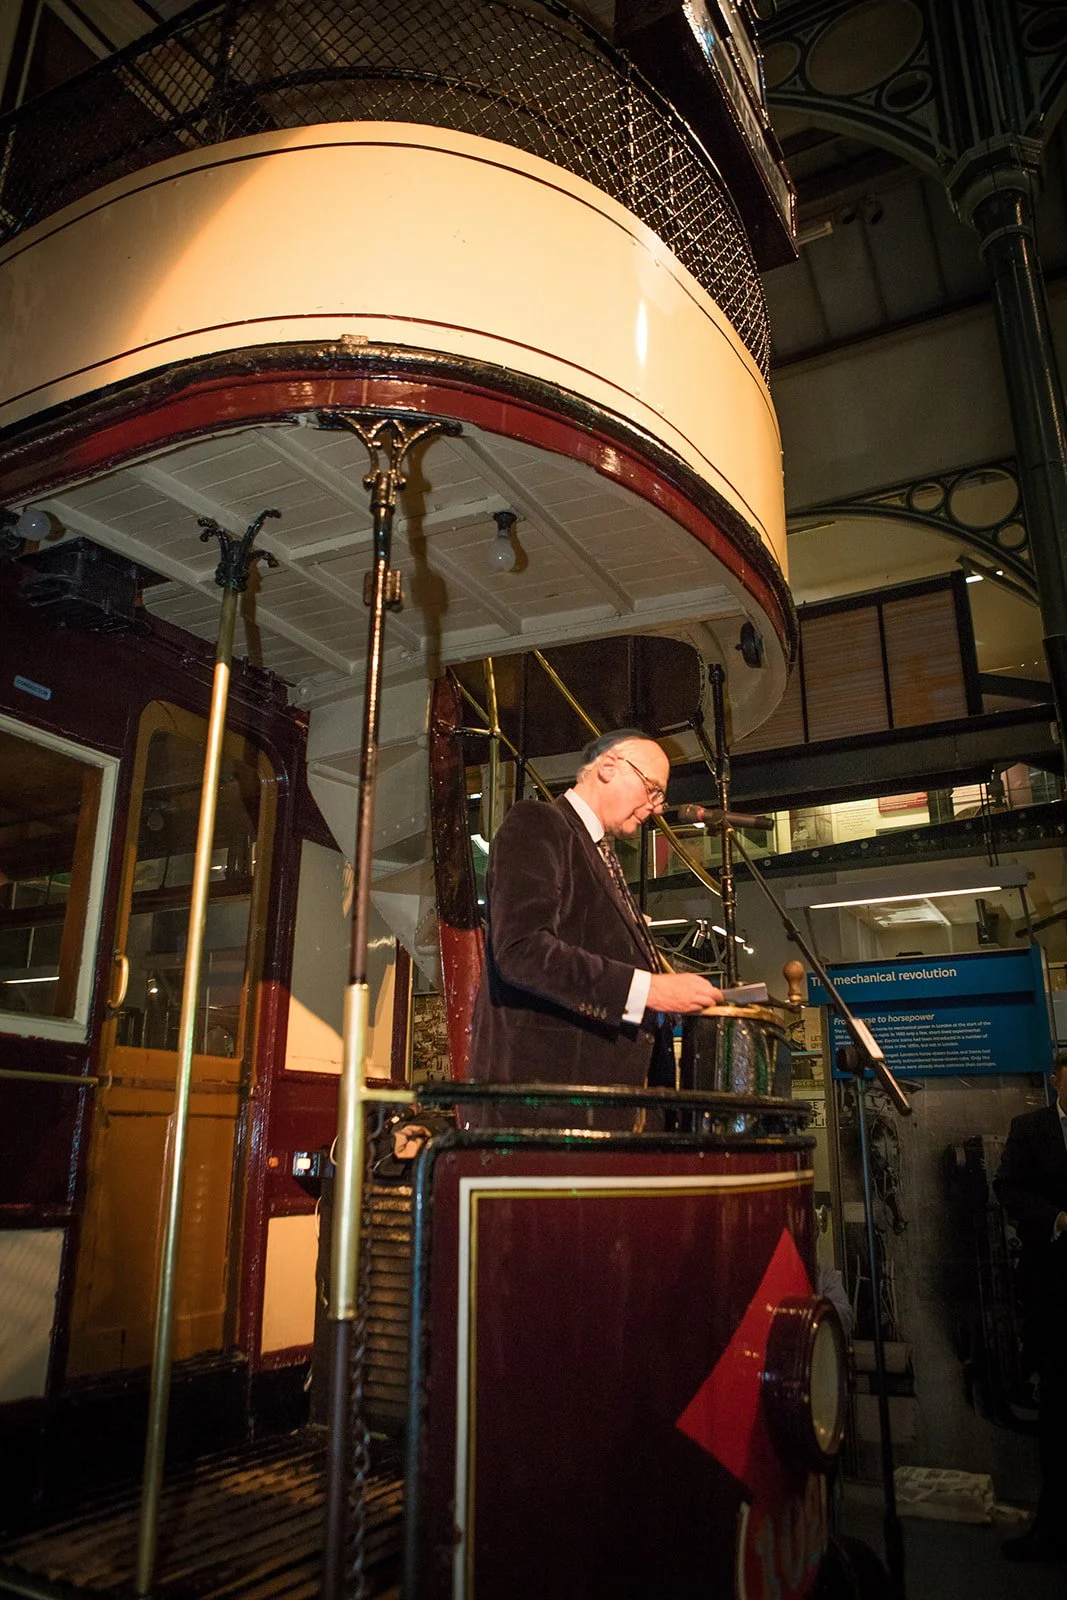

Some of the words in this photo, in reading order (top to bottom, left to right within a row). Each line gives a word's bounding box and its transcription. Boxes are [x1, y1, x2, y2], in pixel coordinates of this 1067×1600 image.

[833, 971, 896, 985] mechanical
[898, 967, 957, 981] revolution
[878, 1015, 887, 1024] to
[888, 1014, 936, 1023] horsepower
